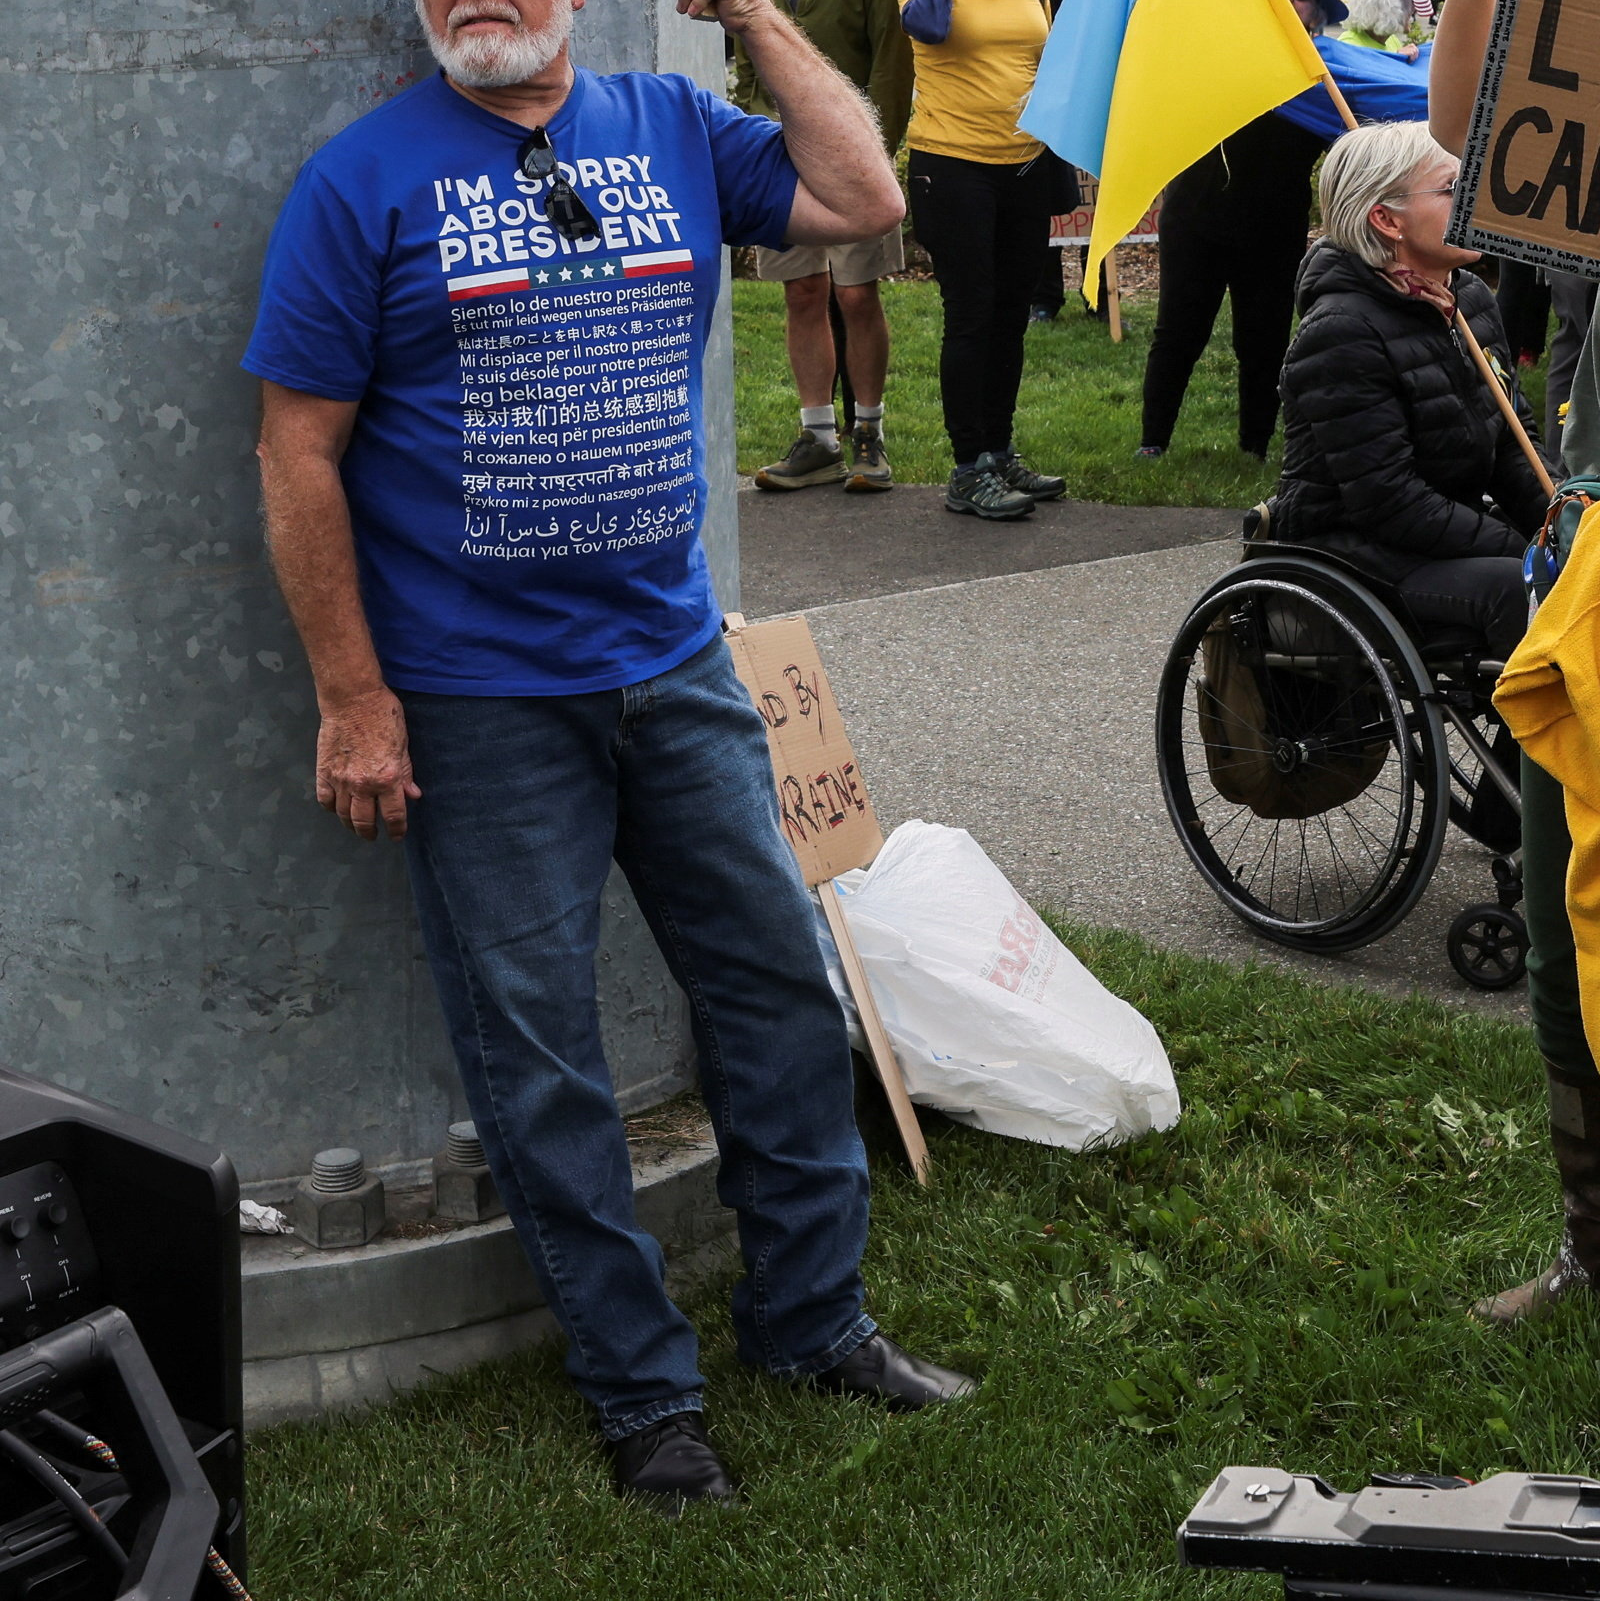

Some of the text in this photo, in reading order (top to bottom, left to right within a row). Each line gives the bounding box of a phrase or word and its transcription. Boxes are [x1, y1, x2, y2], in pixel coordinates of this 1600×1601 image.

[434, 154, 651, 212] I'M SORRY
[598, 185, 673, 213] OUR
[438, 212, 682, 272] PRESIDENT
[451, 280, 694, 322] Siento lo de nuestro presidente.
[453, 296, 694, 333] Es tut mir leid wegen unseres Präsidenten.
[460, 332, 693, 368] Mi dispiace per il nostro presidente.
[460, 371, 474, 384] Je
[477, 369, 506, 384] suis
[510, 364, 560, 381] désolé
[563, 362, 596, 380] pour
[600, 358, 635, 373] notre
[460, 388, 494, 407] Jeg
[499, 383, 586, 403] beklager
[590, 376, 617, 394] vår
[464, 384, 689, 428] 我对我们的总统感到抱歉
[463, 430, 487, 445] Më
[491, 431, 525, 448] vjen
[529, 429, 558, 447] keq
[562, 427, 588, 446] për
[592, 416, 666, 443] presidentin
[463, 429, 692, 464] Я сожалею о нашем президенте
[462, 471, 493, 494] मुझे
[496, 472, 536, 492] हमारे
[633, 458, 655, 478] बारे
[463, 494, 509, 509] Przykro
[512, 497, 529, 508] mi
[532, 498, 539, 508] z
[542, 492, 595, 510] powodu
[598, 486, 644, 502] naszego
[460, 539, 535, 561] Λυπάμαι
[541, 544, 568, 560] για
[572, 541, 602, 554] τον
[676, 517, 695, 538] μας
[779, 761, 866, 848] KRAINE
